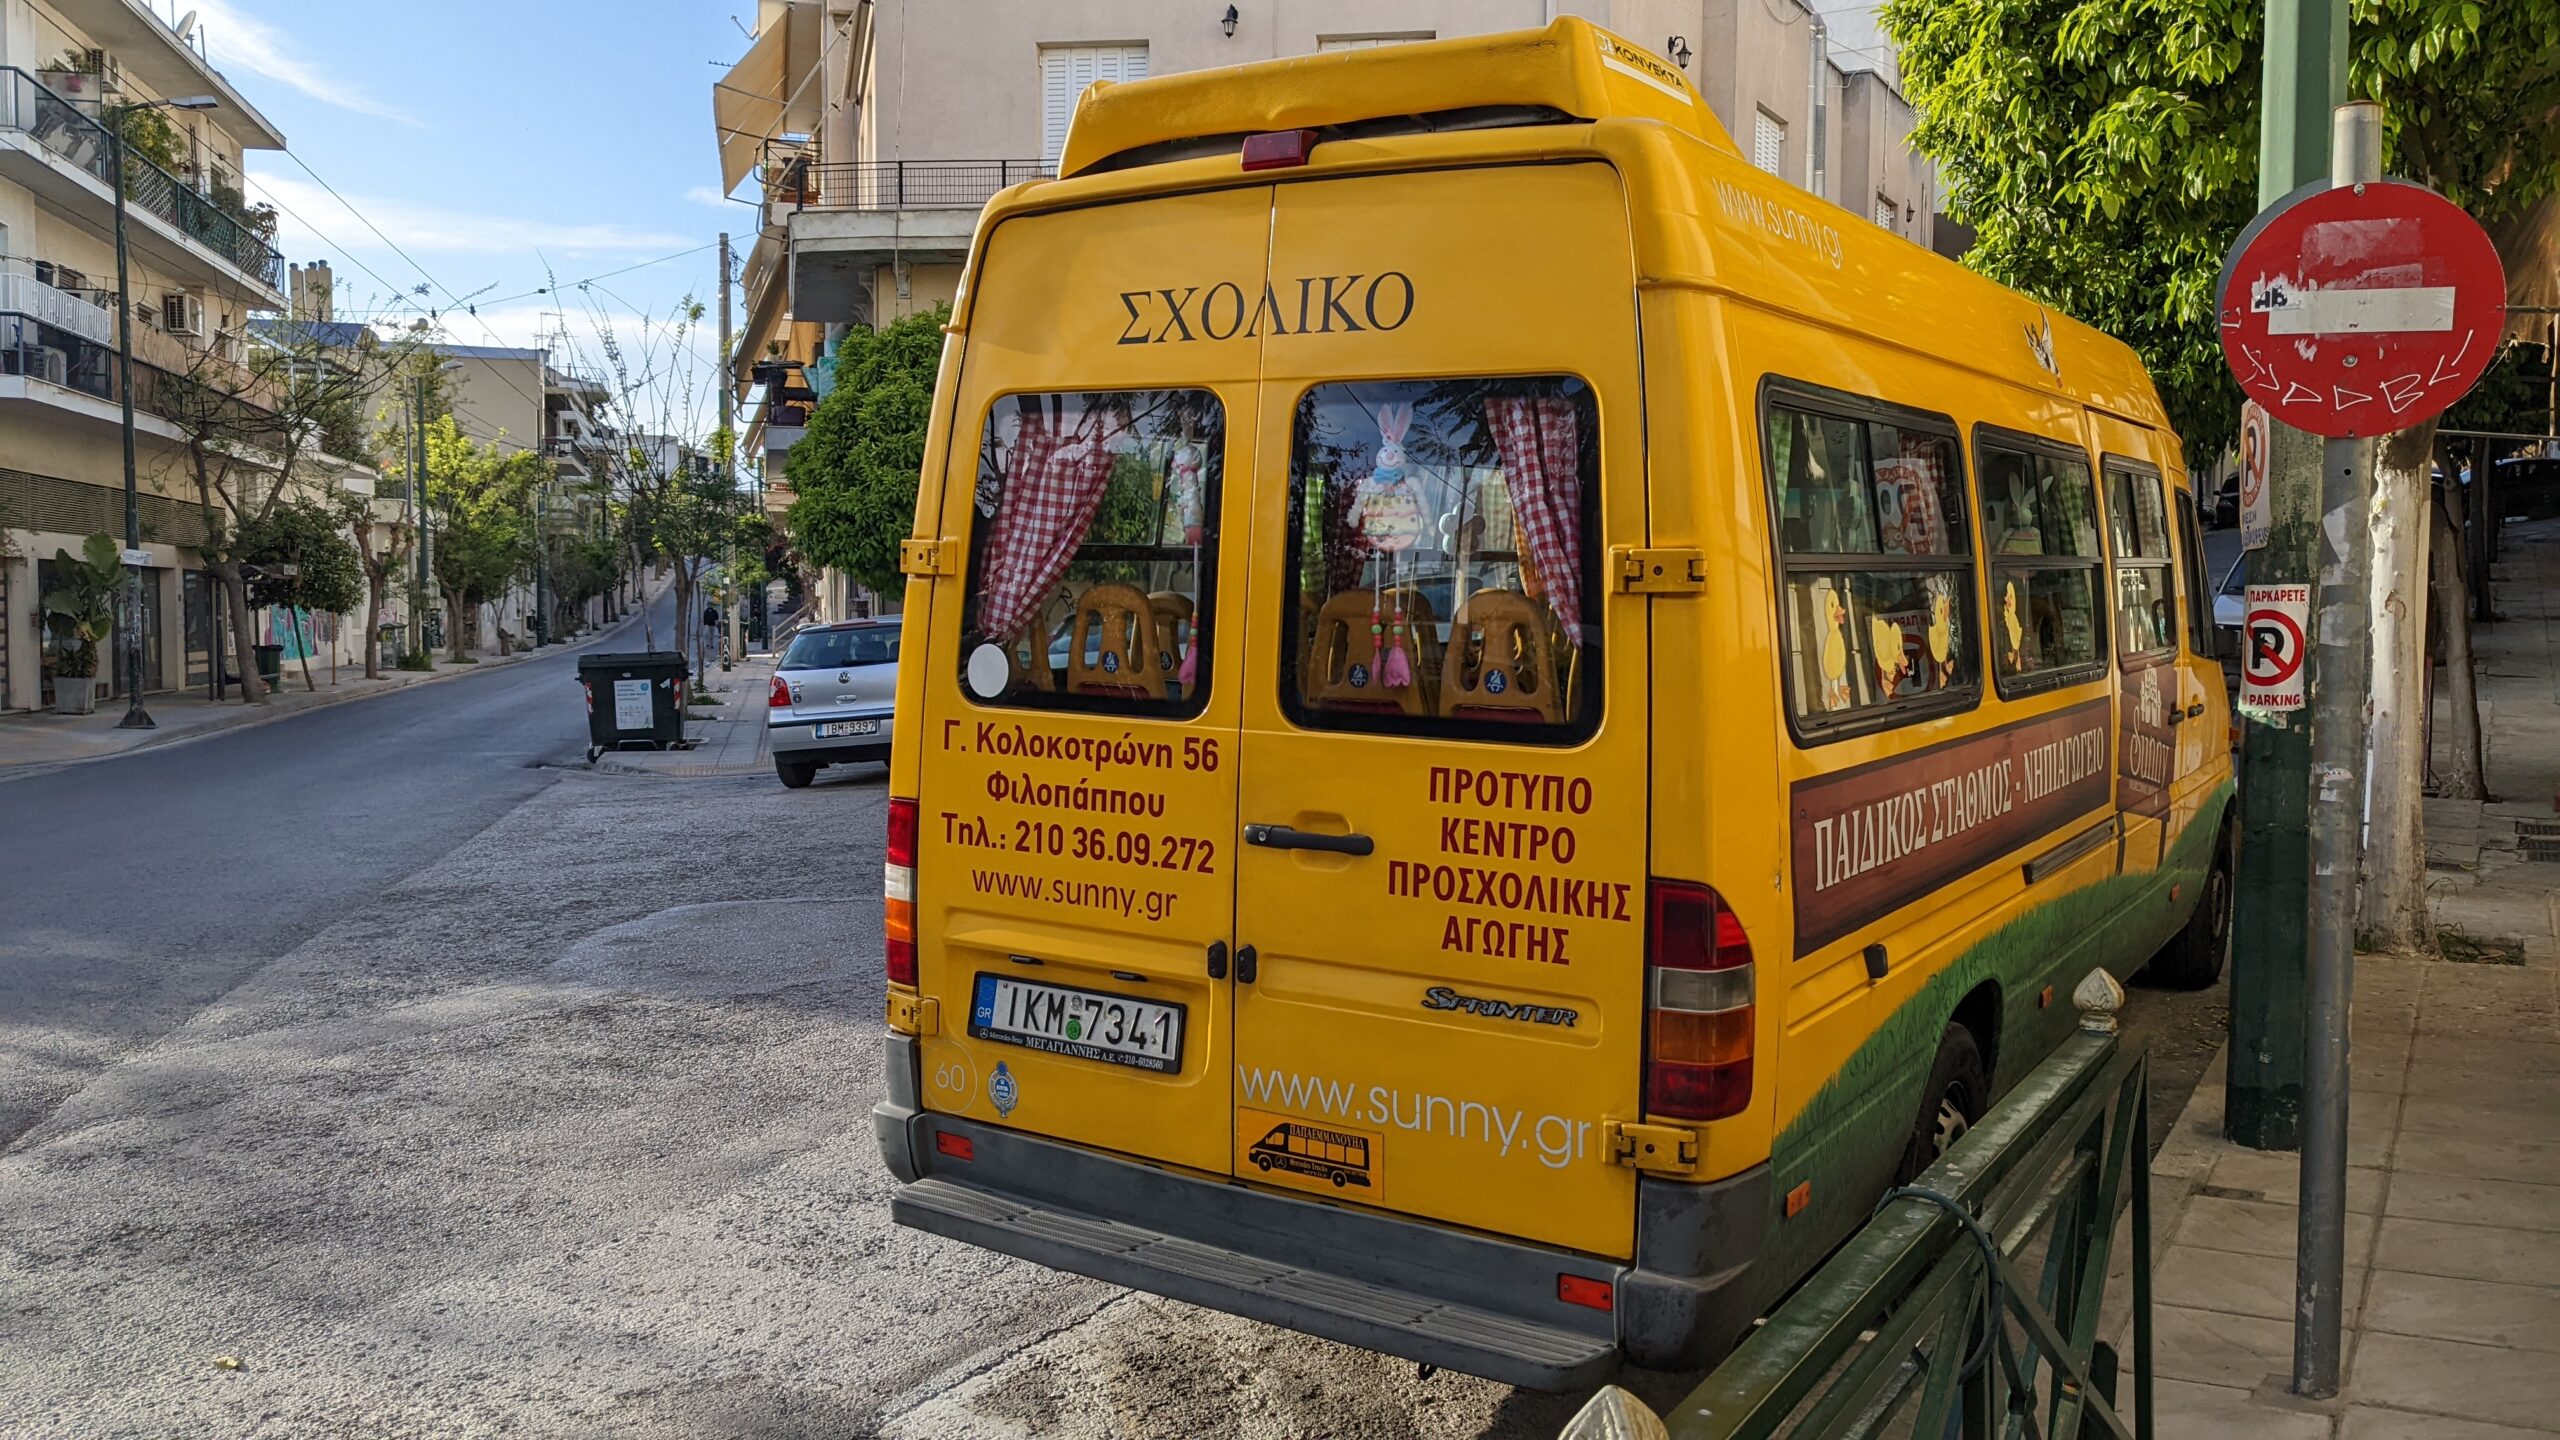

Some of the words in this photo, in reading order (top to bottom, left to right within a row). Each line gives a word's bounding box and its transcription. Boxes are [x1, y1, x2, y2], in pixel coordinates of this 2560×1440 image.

[1611, 39, 1684, 88] KONVEKTA
[1712, 176, 1842, 269] www.sunny.gr
[1117, 271, 1415, 346] ΣΧΟΛΙΚΟ
[2250, 589, 2306, 603] ΠΑΡΚΑΡΕΤΕ
[2249, 693, 2301, 706] PARKING
[943, 719, 967, 751] Γ.
[976, 721, 1173, 772] Κολοκοτρώνη
[1183, 736, 1219, 772] 56
[2130, 706, 2170, 790] Sunny
[986, 770, 1165, 818] Φιλοπάππου
[1429, 766, 1593, 815] ΠΡΟΤΥΠΟ
[1814, 787, 1928, 893] ΠΑΙΔΙΚΟΣ
[1931, 758, 2013, 845] ΣΤΑΘΜΟΣ
[2023, 726, 2105, 805] ΝΗΠΙΑΓΩΓΕΙΟ
[941, 812, 1006, 850] Τηλ.:
[1015, 820, 1064, 856] 210
[1072, 826, 1215, 874] 36.09.272
[1440, 816, 1576, 864] ΚΕΝΤΡΟ
[972, 869, 1178, 922] www.sunny.gr
[1388, 860, 1632, 922] ΠΡΟΣΧΟΛΙΚΗΣ
[1441, 915, 1570, 965] ΑΓΩΓΗΣ
[977, 1006, 991, 1019] GR
[1025, 1036, 1101, 1060] ΜΕΓΑΓΙΑΝΝΗΣ
[935, 1062, 965, 1092] 60
[1238, 1064, 1592, 1169] www.sunny.gr
[1289, 1124, 1364, 1149] ΠΑΠΑΕΜΜΑΝΟΥΗΛ
